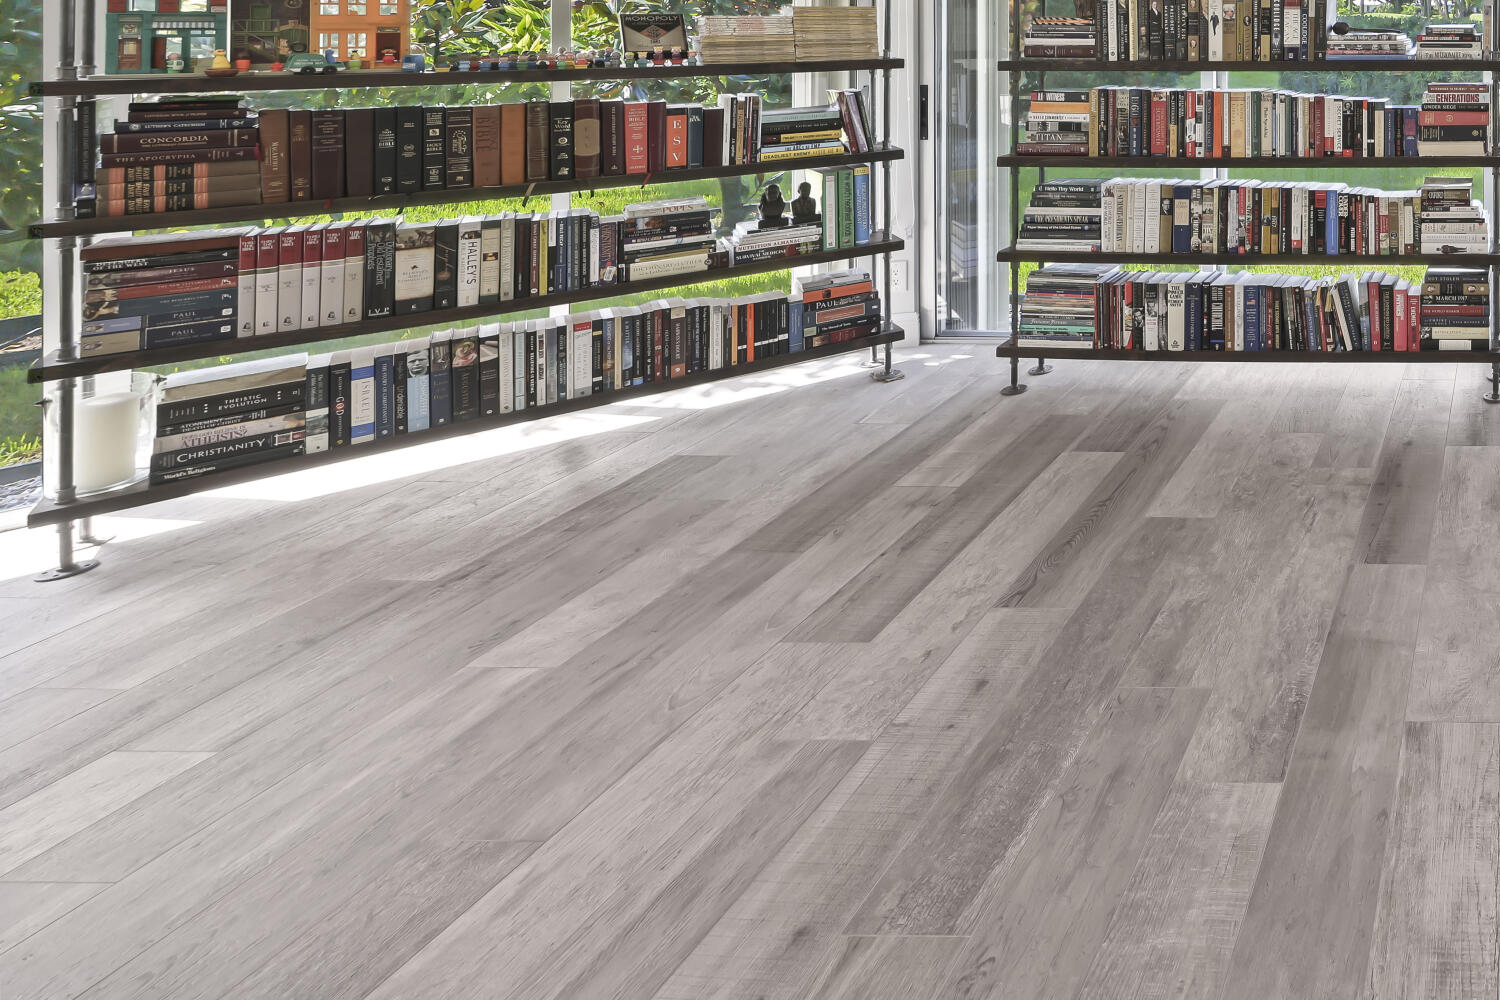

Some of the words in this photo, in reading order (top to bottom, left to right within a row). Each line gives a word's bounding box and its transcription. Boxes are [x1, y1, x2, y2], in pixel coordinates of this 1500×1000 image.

[1436, 94, 1479, 102] GENERATIONS
[1131, 96, 1139, 116] 1960
[140, 135, 209, 145] CONCORDIA
[139, 154, 196, 162] APOCRYPHA
[793, 150, 811, 158] ENEMY
[662, 204, 693, 214] POPES
[738, 242, 772, 251] NUTRITION
[773, 238, 801, 247] ALMANAC
[367, 243, 376, 270] Prophets
[385, 241, 394, 272] Dictionary
[735, 253, 761, 261] SURVIVAL
[761, 249, 787, 257] MEDICINE
[467, 241, 477, 285] HALLEY'S
[816, 300, 838, 310] PAUL
[1212, 303, 1223, 330] CHURCHILL
[218, 398, 267, 411] EVOLUTION
[224, 393, 262, 405] THEISTIC
[181, 417, 223, 429] ATONEMENT
[182, 429, 248, 449] ATHEISTS?
[176, 438, 266, 463] CHRISTIANITY
